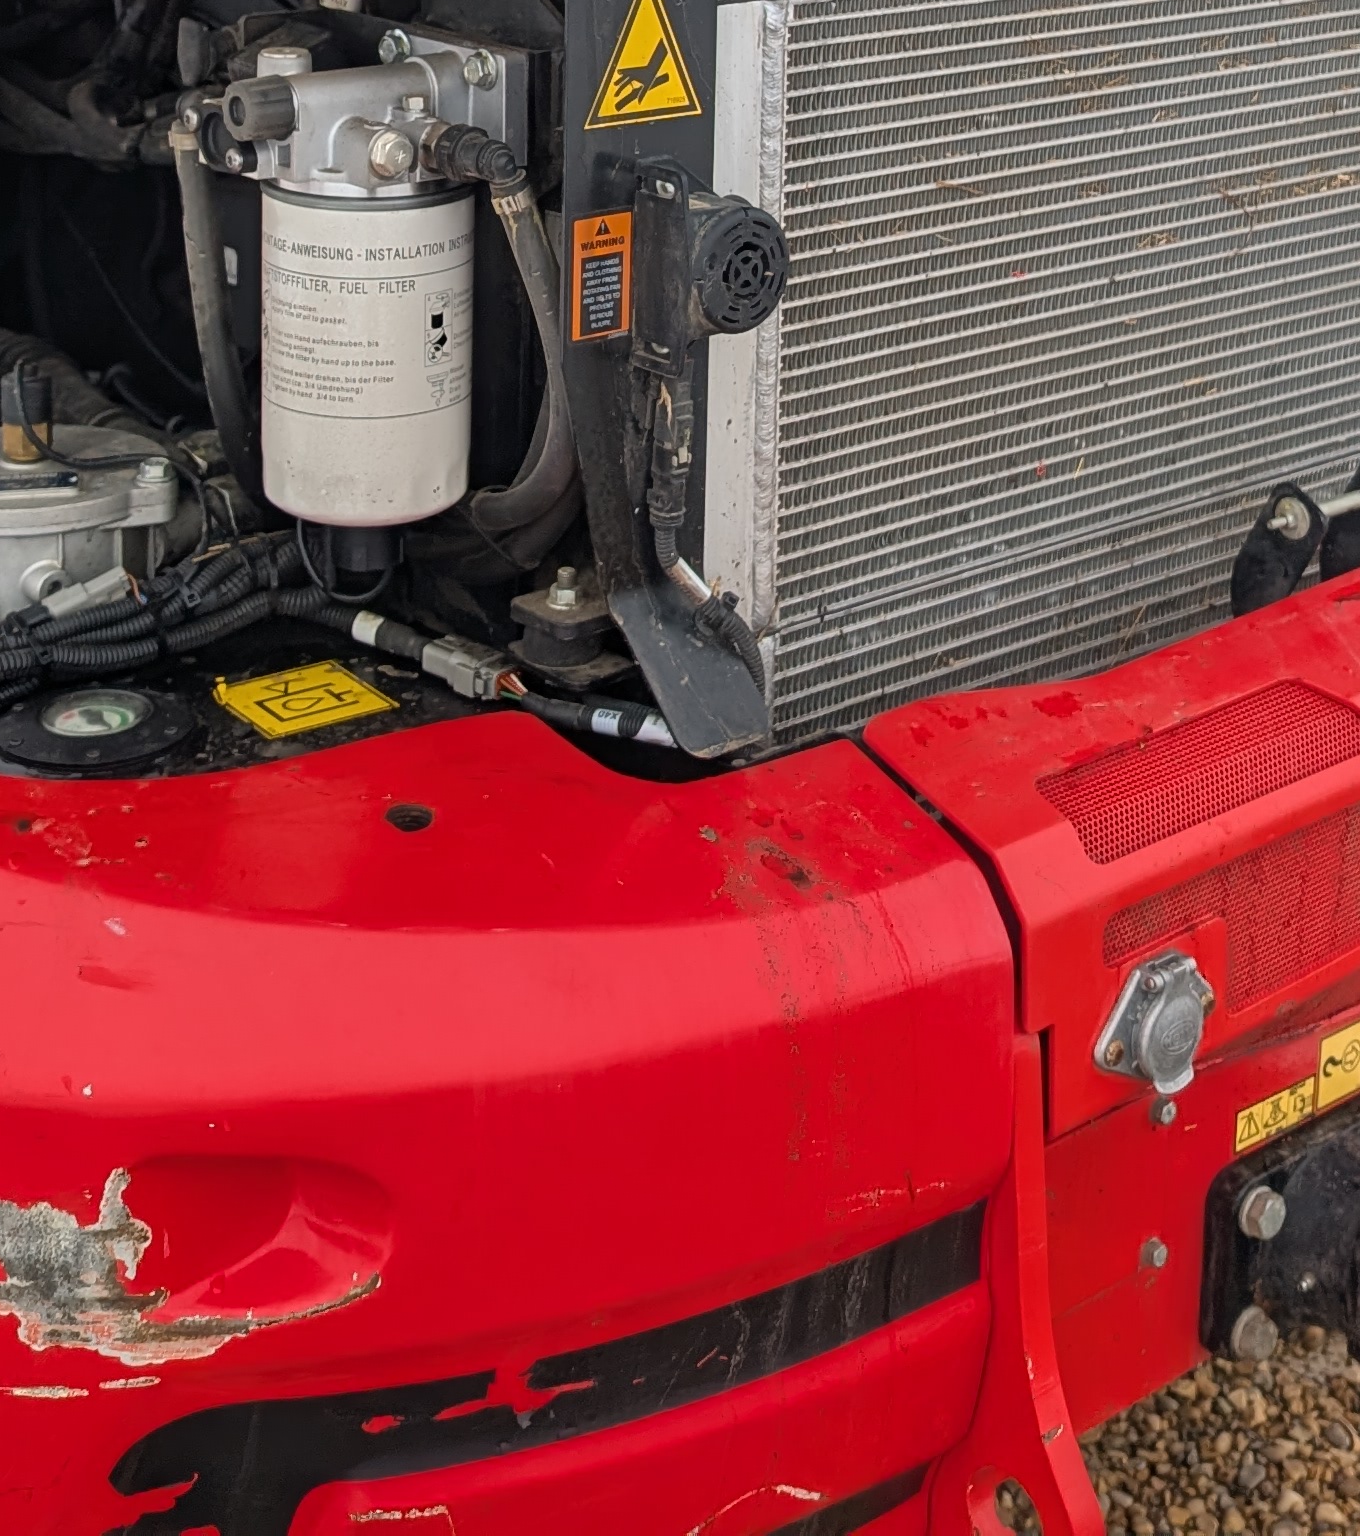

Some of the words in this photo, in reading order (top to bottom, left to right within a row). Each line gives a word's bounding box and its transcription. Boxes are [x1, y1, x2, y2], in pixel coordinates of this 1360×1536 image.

[581, 235, 625, 252] WARNING
[365, 242, 445, 262] INSTALLATION
[585, 261, 600, 270] KEEP
[339, 281, 369, 295] FUEL
[378, 279, 416, 294] FILTER
[321, 357, 340, 366] hand
[361, 359, 374, 367] the
